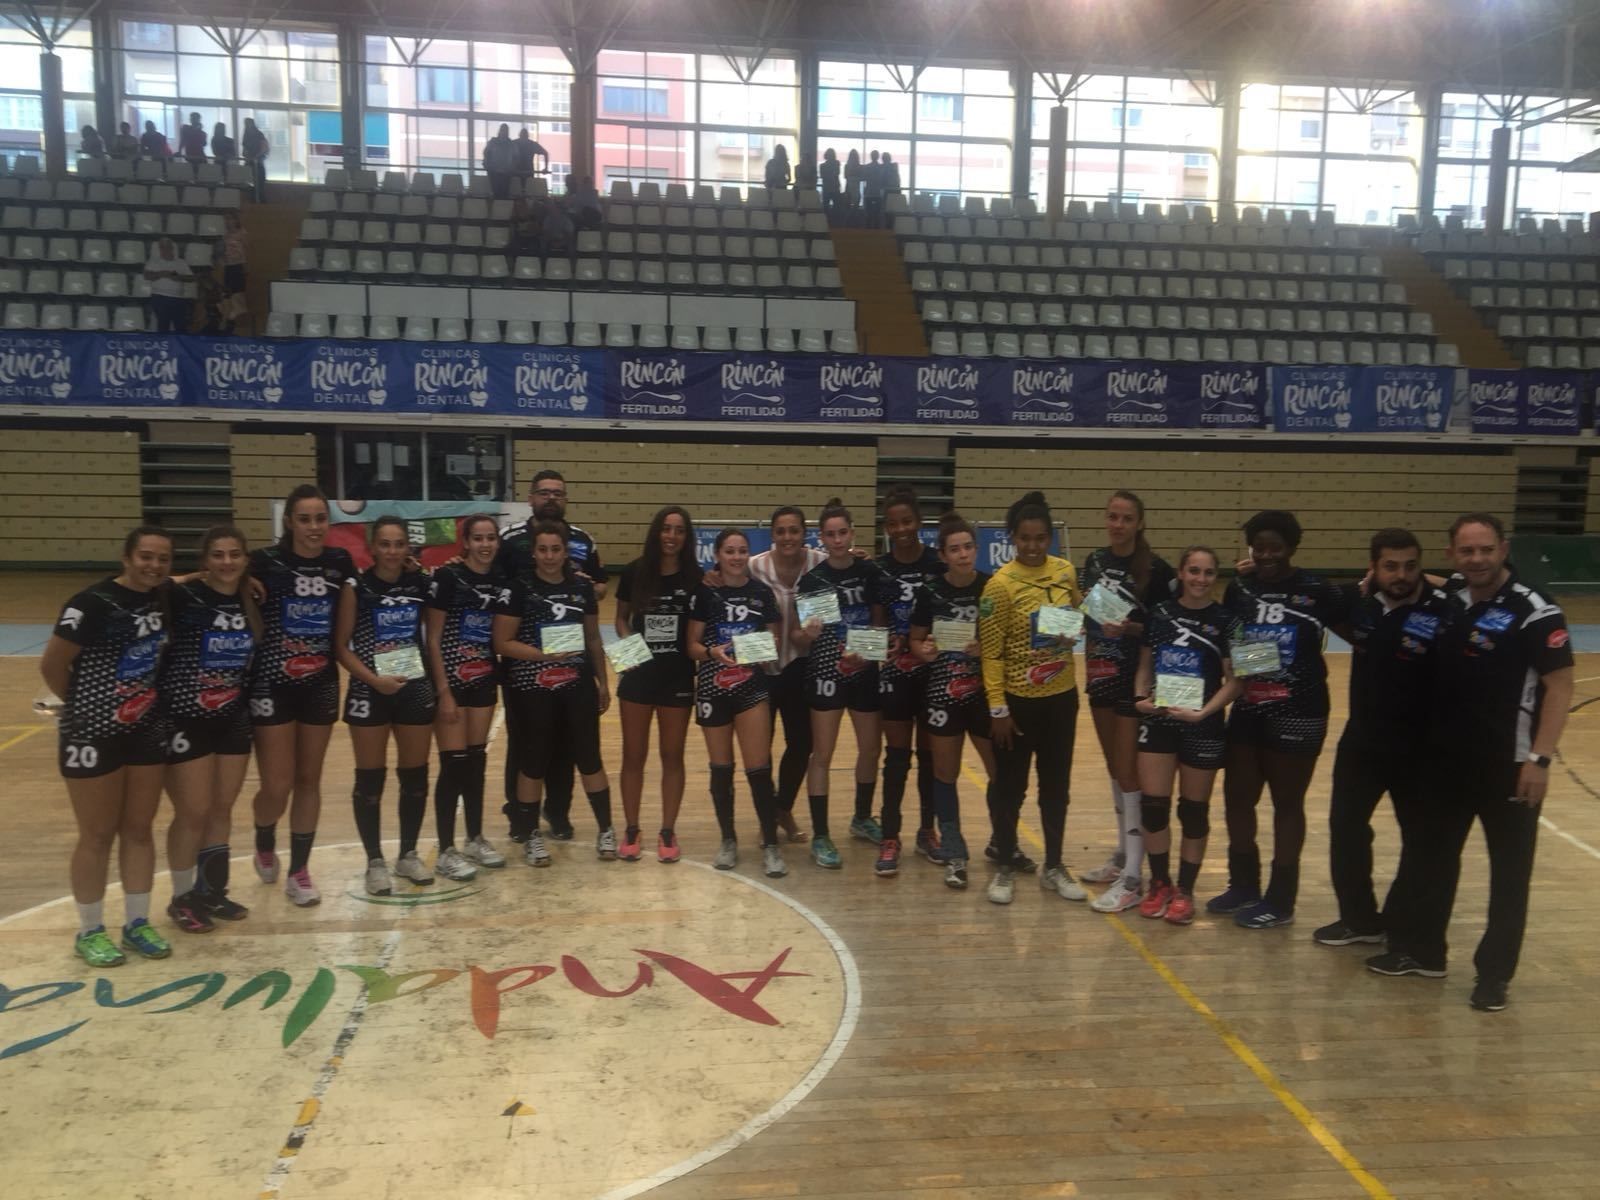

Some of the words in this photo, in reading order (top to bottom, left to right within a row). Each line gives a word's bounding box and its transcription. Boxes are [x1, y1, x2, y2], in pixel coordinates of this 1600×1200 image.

[107, 340, 169, 351] CLINICAS
[214, 343, 275, 354] CLINICAS
[318, 346, 379, 357] CLINICAS
[421, 348, 480, 359] CLINICAS
[522, 352, 582, 364] CLINICAS
[104, 387, 160, 399] DENTAL
[208, 389, 264, 401] DENTAL
[313, 392, 369, 404] DENTAL
[417, 394, 471, 406] DENTAL
[518, 398, 571, 410] DENTAL
[620, 403, 687, 415] FERTILIDAD
[721, 405, 786, 417] FERTILIDAD
[820, 407, 883, 418] FERTILIDAD
[916, 409, 979, 420] FERTILIDAD
[1012, 411, 1074, 422] FERTILIDAD
[1106, 412, 1168, 423] FERTILIDAD
[1201, 413, 1260, 424] FERTILIDAD
[295, 576, 328, 596] 88
[551, 603, 566, 621] 9
[725, 605, 748, 622] 19
[1256, 602, 1285, 624] 18
[1172, 626, 1190, 647] 2
[816, 679, 836, 697] 10
[349, 700, 370, 718] 23
[928, 708, 948, 728] 29
[1138, 725, 1148, 743] 2
[65, 745, 98, 768] 20
